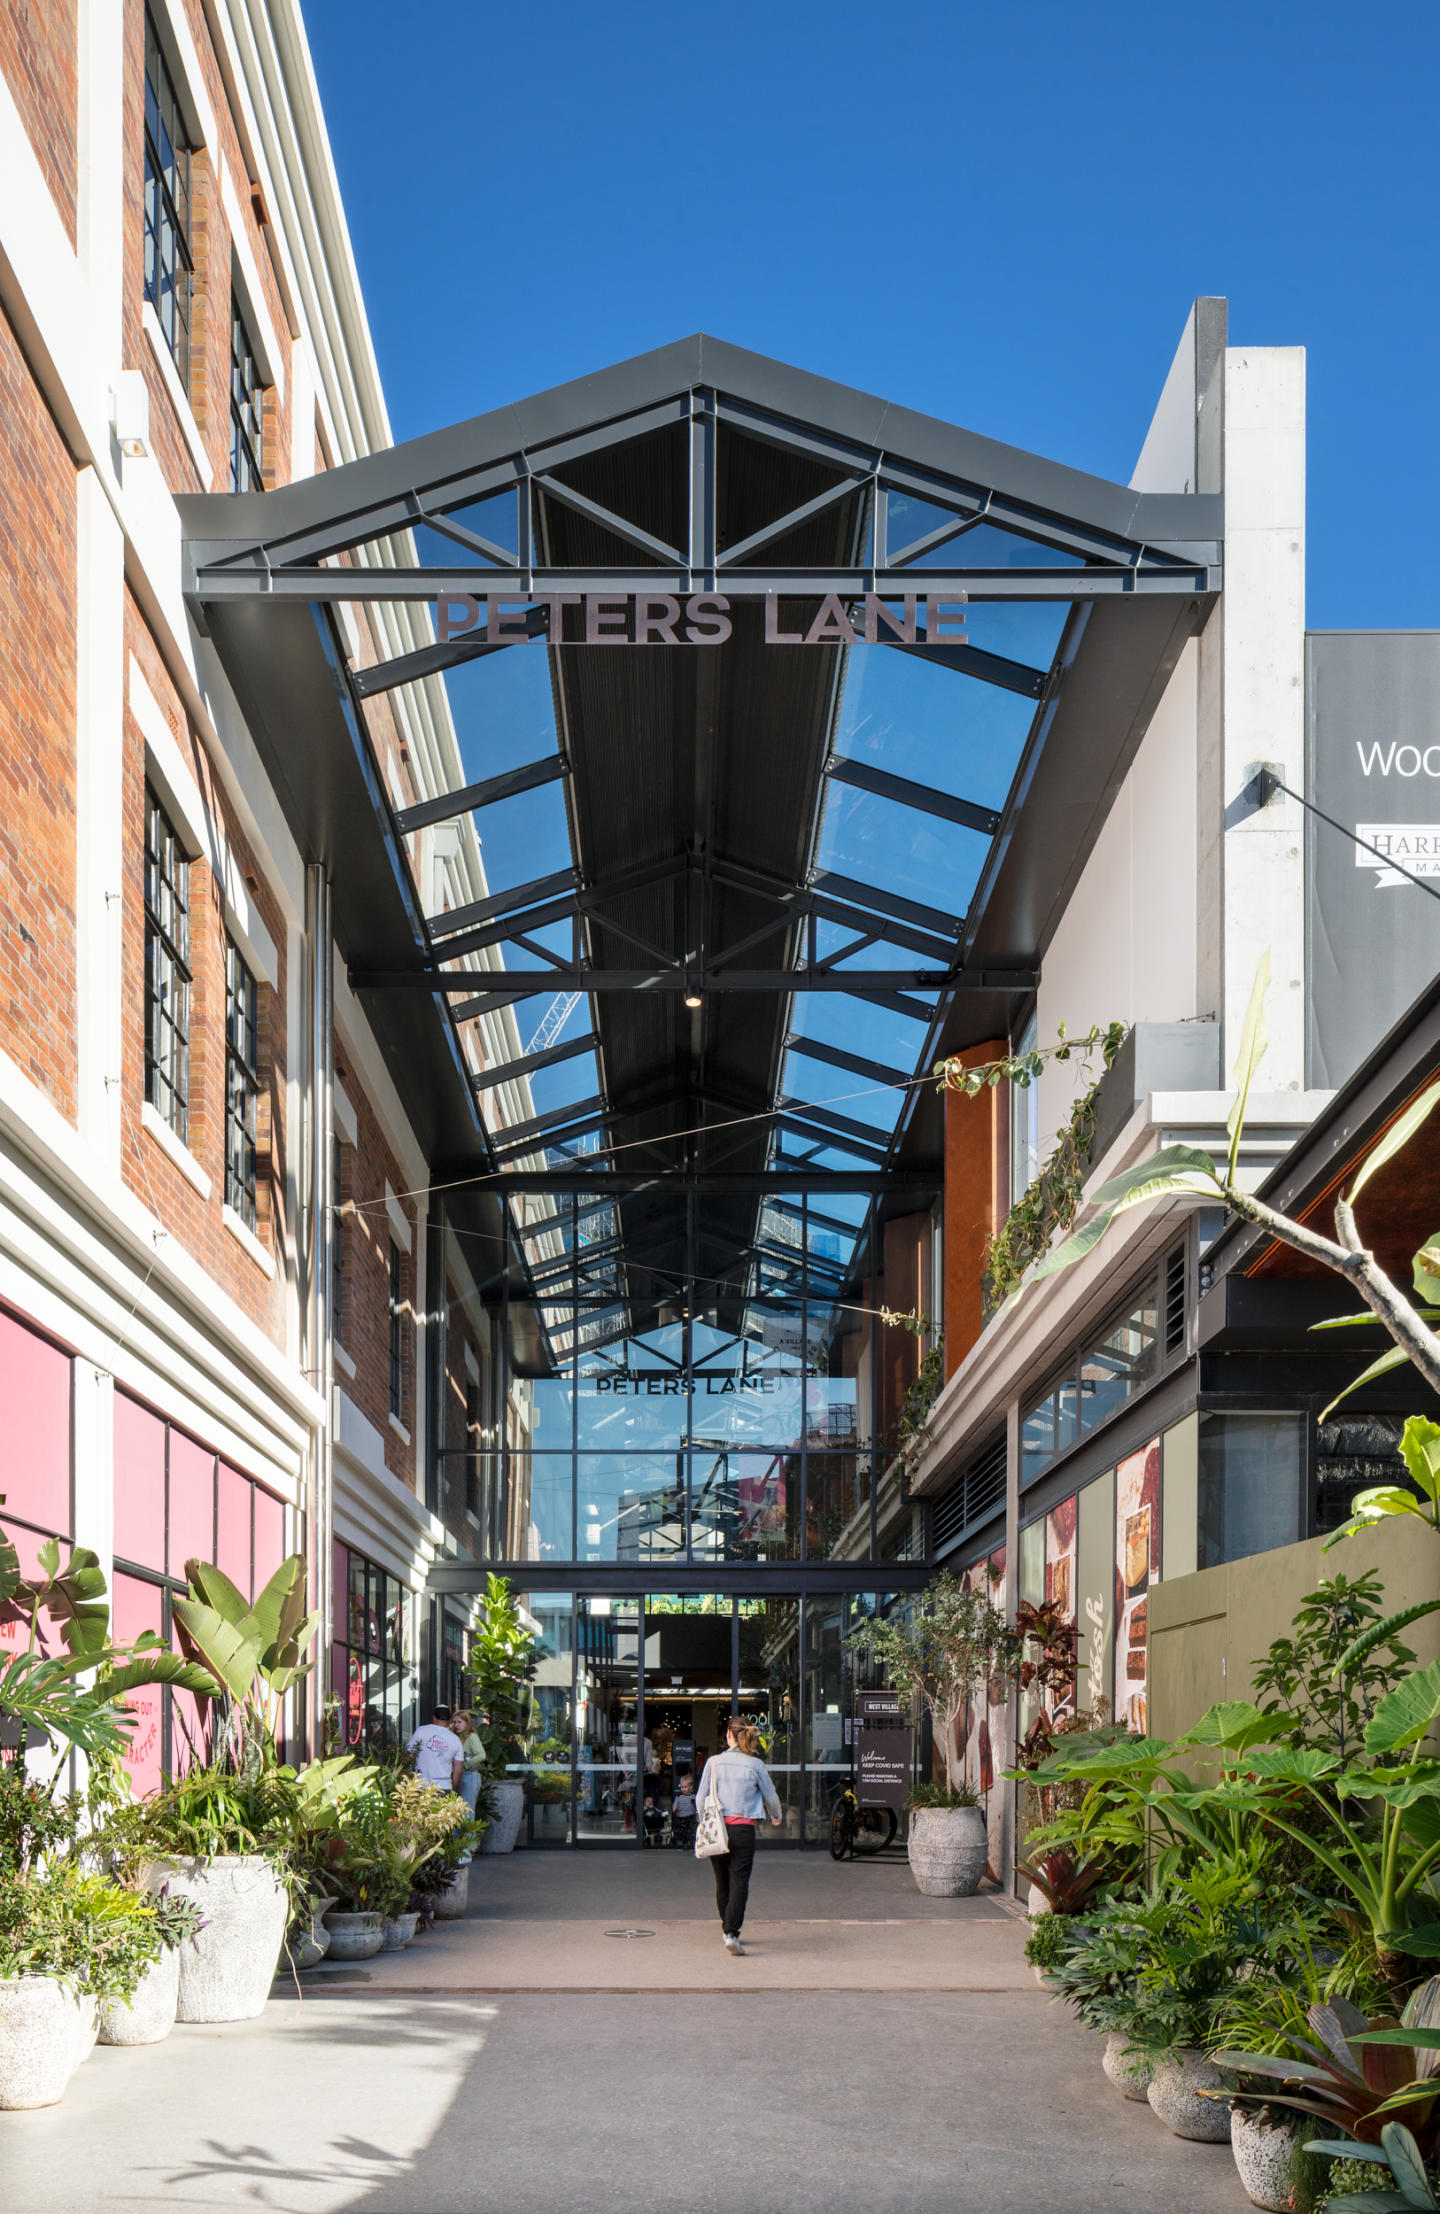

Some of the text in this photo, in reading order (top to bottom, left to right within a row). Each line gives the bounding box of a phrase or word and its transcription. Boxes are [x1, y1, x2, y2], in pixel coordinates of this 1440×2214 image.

[437, 593, 969, 645] PETERS LANE
[597, 1377, 775, 1396] PETERS LANE
